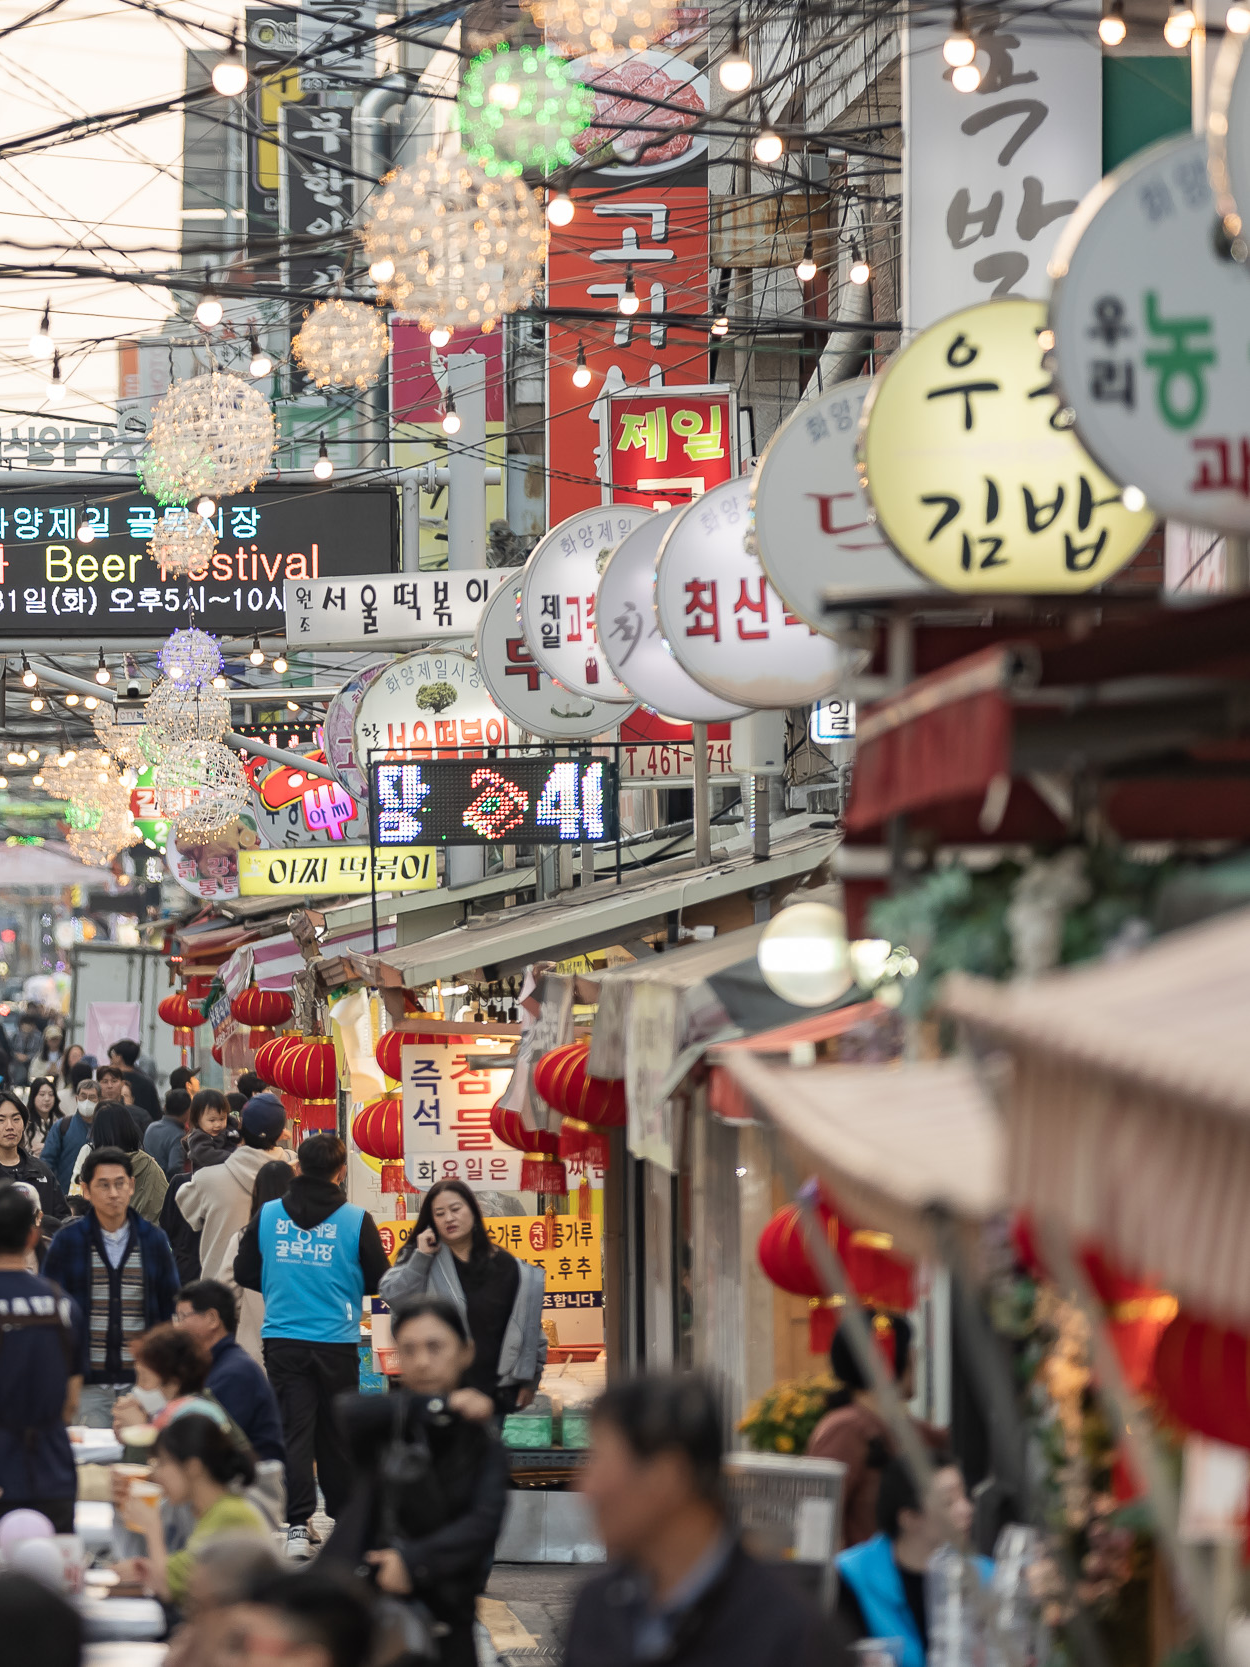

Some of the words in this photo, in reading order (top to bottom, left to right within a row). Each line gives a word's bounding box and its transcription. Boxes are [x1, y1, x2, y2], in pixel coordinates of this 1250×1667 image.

[616, 405, 725, 463] 제일
[920, 475, 1124, 573] 김밥
[45, 545, 142, 584] Beer
[296, 586, 314, 633] 원조
[322, 578, 489, 635] 서울떡볶이
[541, 594, 561, 649] 제일
[385, 658, 481, 695] 화양제일시장
[268, 856, 329, 884] 아찌
[410, 1059, 443, 1136] 즉석
[417, 1158, 509, 1183] 화요일은
[276, 1240, 335, 1261] 골목시장
[531, 1224, 546, 1251] 국산
